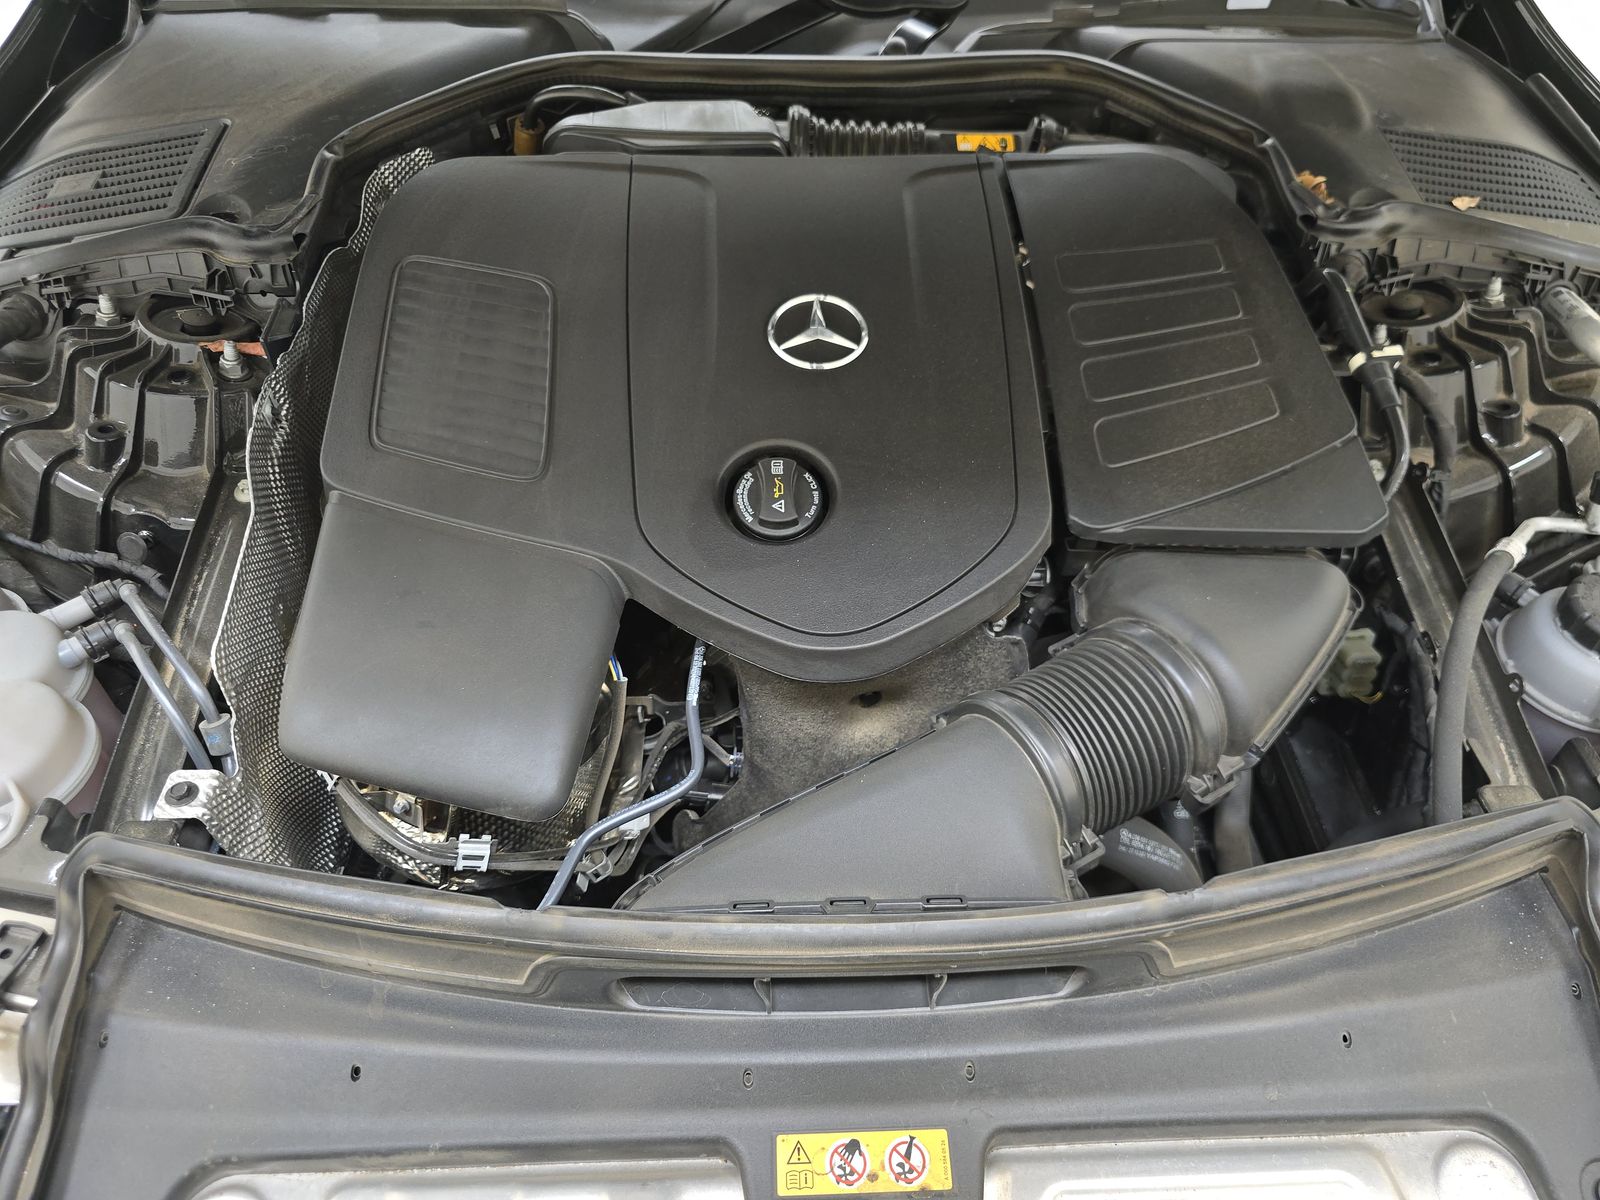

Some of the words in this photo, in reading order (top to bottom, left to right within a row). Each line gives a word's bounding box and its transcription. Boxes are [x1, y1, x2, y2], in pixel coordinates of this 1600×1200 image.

[803, 472, 818, 490] CLICK
[736, 479, 753, 523] Mercedes-Benz
[804, 505, 817, 519] Turn
